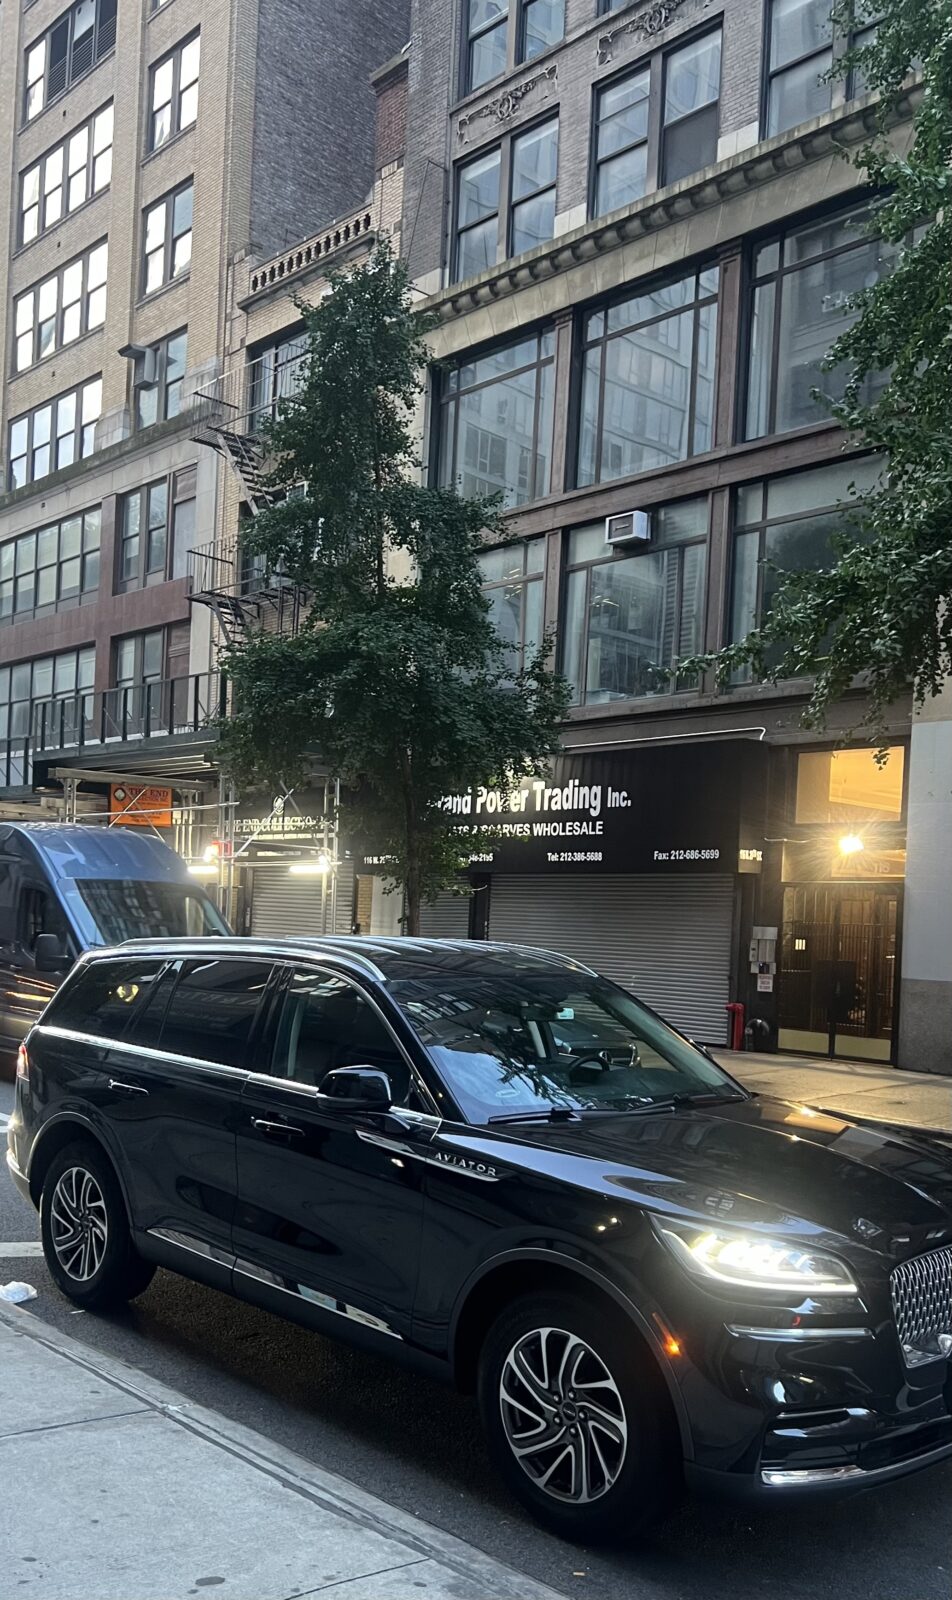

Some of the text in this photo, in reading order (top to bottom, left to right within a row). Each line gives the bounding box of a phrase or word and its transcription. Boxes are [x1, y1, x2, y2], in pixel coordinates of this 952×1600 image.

[426, 786, 472, 815] rand
[533, 779, 602, 817] Trading
[607, 786, 632, 808] Inc.
[532, 821, 604, 837] WHOLESALE
[547, 852, 559, 861] Tel:
[653, 849, 720, 860] Fax: 212-686-5699
[434, 1152, 496, 1176] AVIATOR
